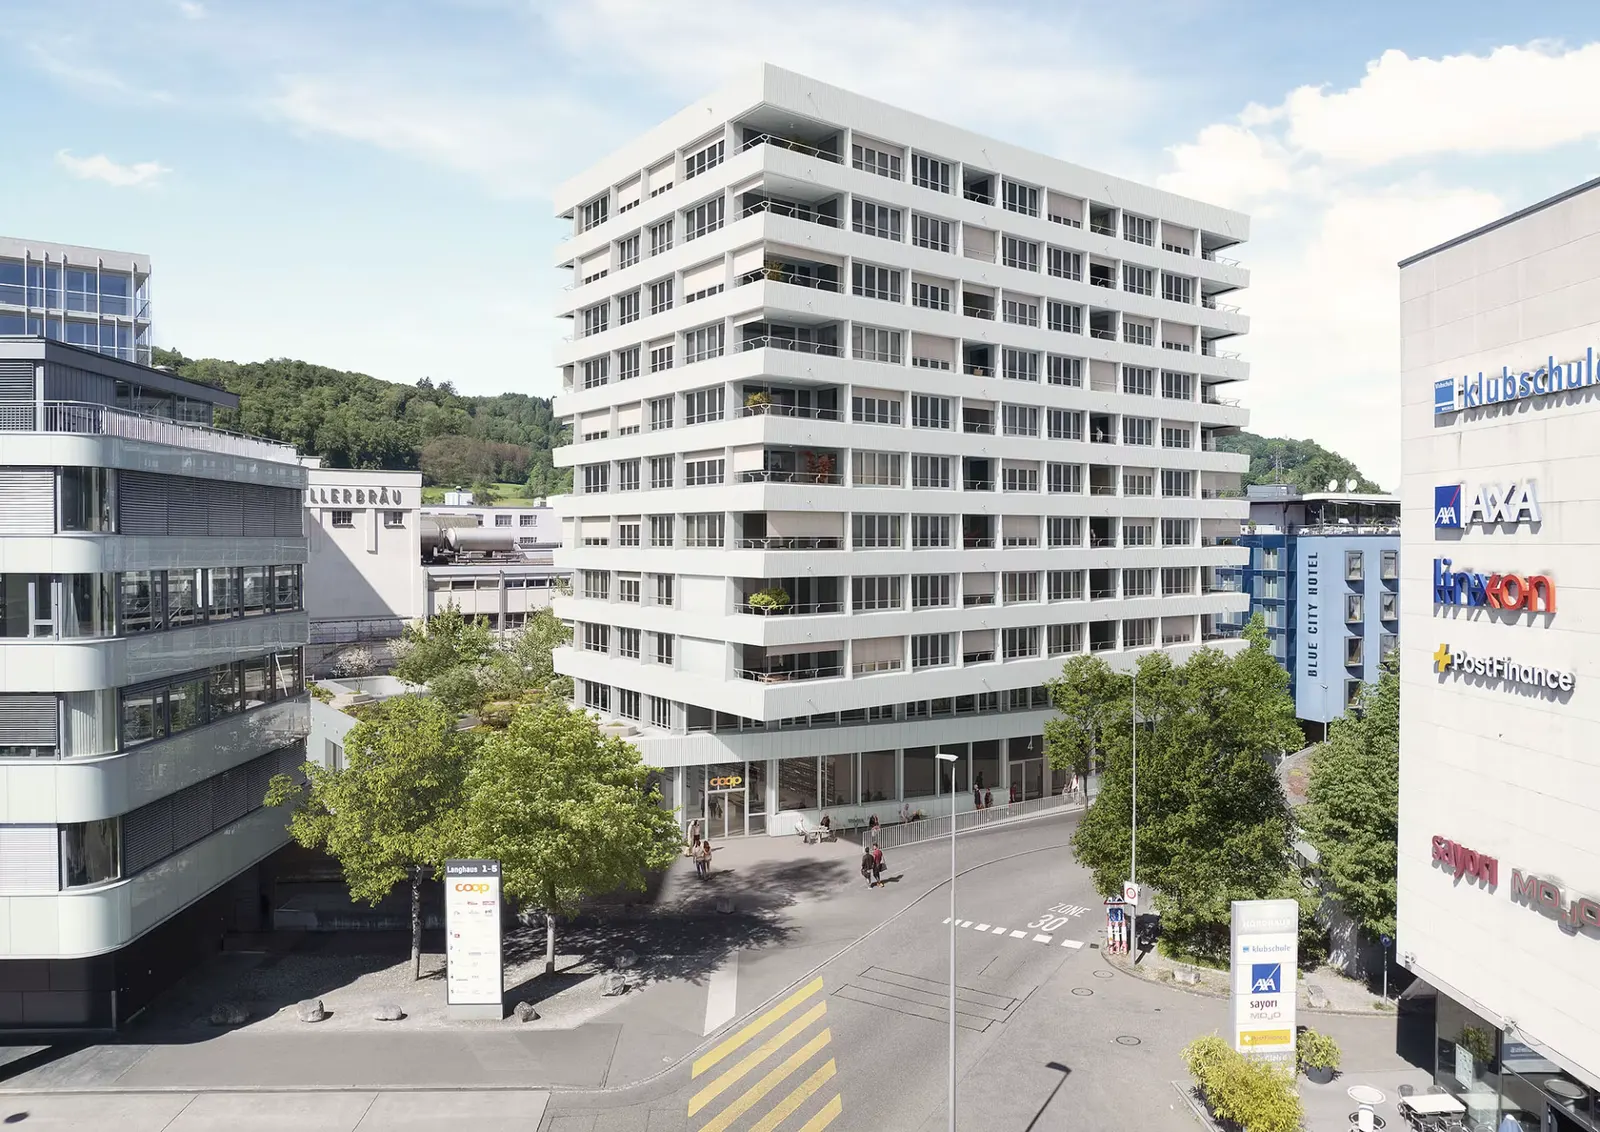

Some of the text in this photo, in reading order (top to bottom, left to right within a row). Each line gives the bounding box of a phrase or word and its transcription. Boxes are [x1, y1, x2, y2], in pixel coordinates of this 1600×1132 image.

[1463, 347, 1600, 408] klubschul
[303, 486, 402, 505] LLERBRÄU
[1435, 484, 1541, 524] AXA AXA
[1308, 552, 1318, 677] BLUE CITY HOTEL
[1454, 649, 1575, 692] PostFinance
[710, 776, 742, 787] coop
[447, 866, 478, 875] Langhaus
[455, 883, 490, 894] coop
[1048, 902, 1091, 918] ZONE
[1027, 914, 1068, 931] 30
[1252, 978, 1276, 991] AXA
